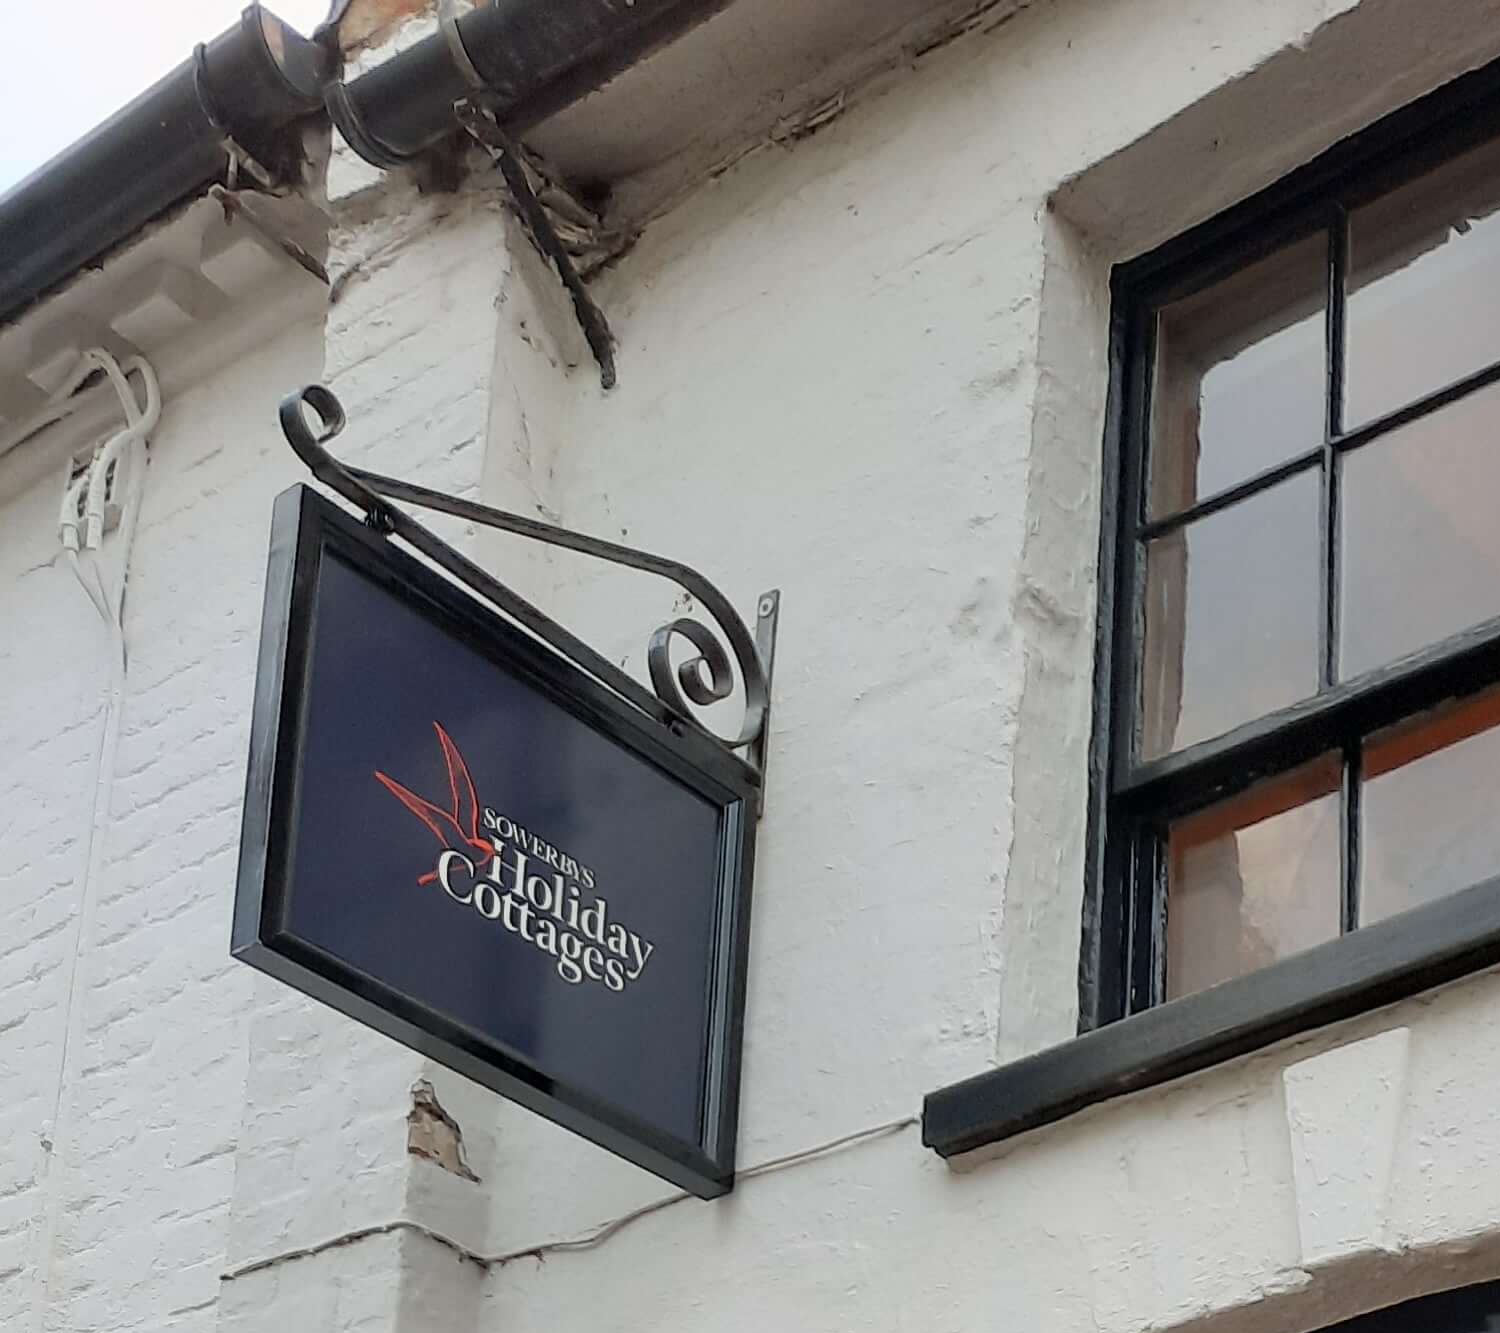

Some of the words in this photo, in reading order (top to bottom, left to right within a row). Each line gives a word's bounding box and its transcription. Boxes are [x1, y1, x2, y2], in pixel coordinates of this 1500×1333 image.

[483, 808, 596, 888] SOWERBYS
[487, 837, 655, 980] Holiday
[438, 848, 627, 992] Cottages
